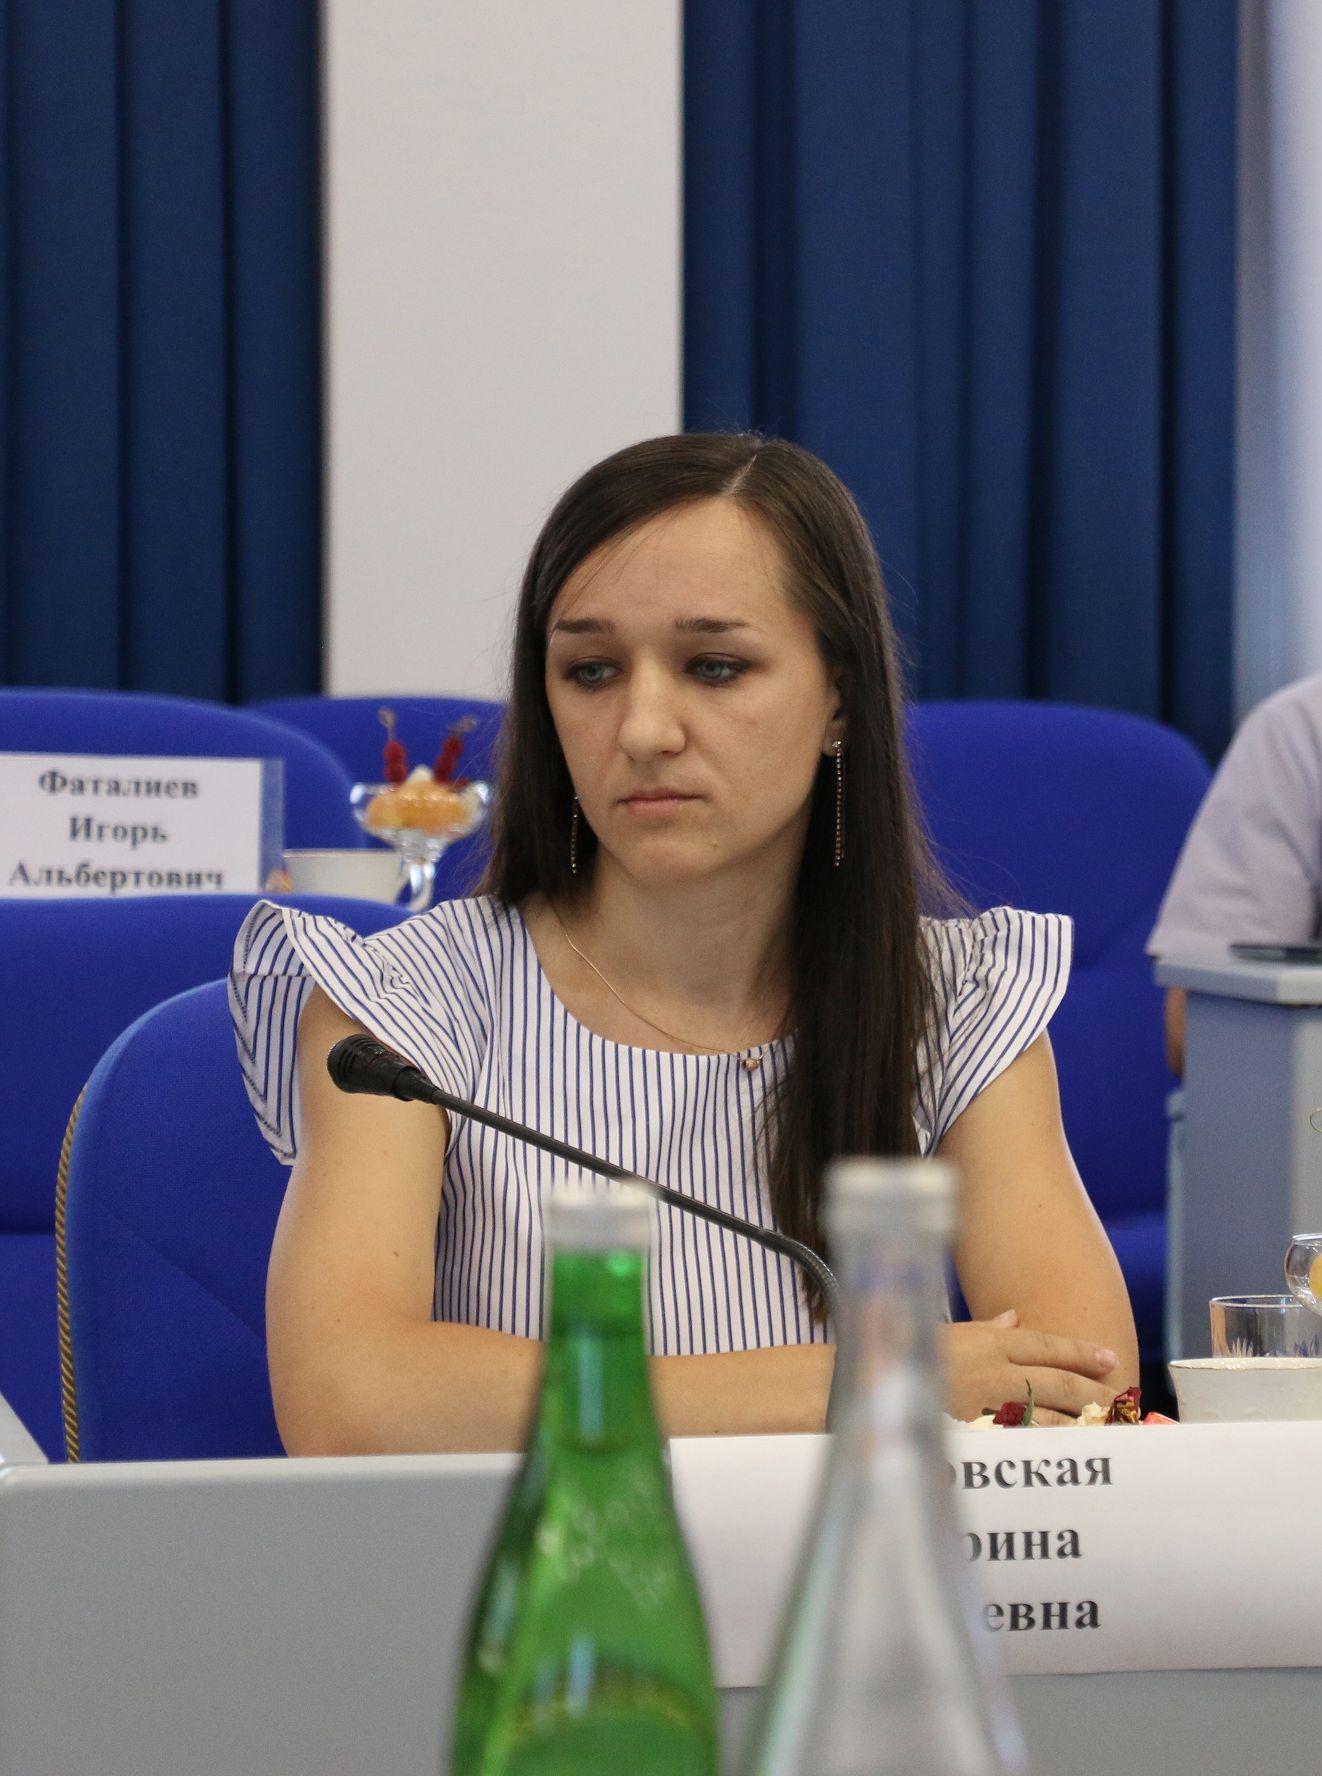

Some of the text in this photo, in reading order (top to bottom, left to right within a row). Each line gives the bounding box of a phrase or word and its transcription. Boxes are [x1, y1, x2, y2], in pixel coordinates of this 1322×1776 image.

[38, 769, 200, 799] Фаталиев
[68, 815, 169, 851] Игорь
[8, 860, 224, 896] Альбертович
[949, 1456, 1114, 1490] вская
[980, 1599, 1102, 1632] евна
